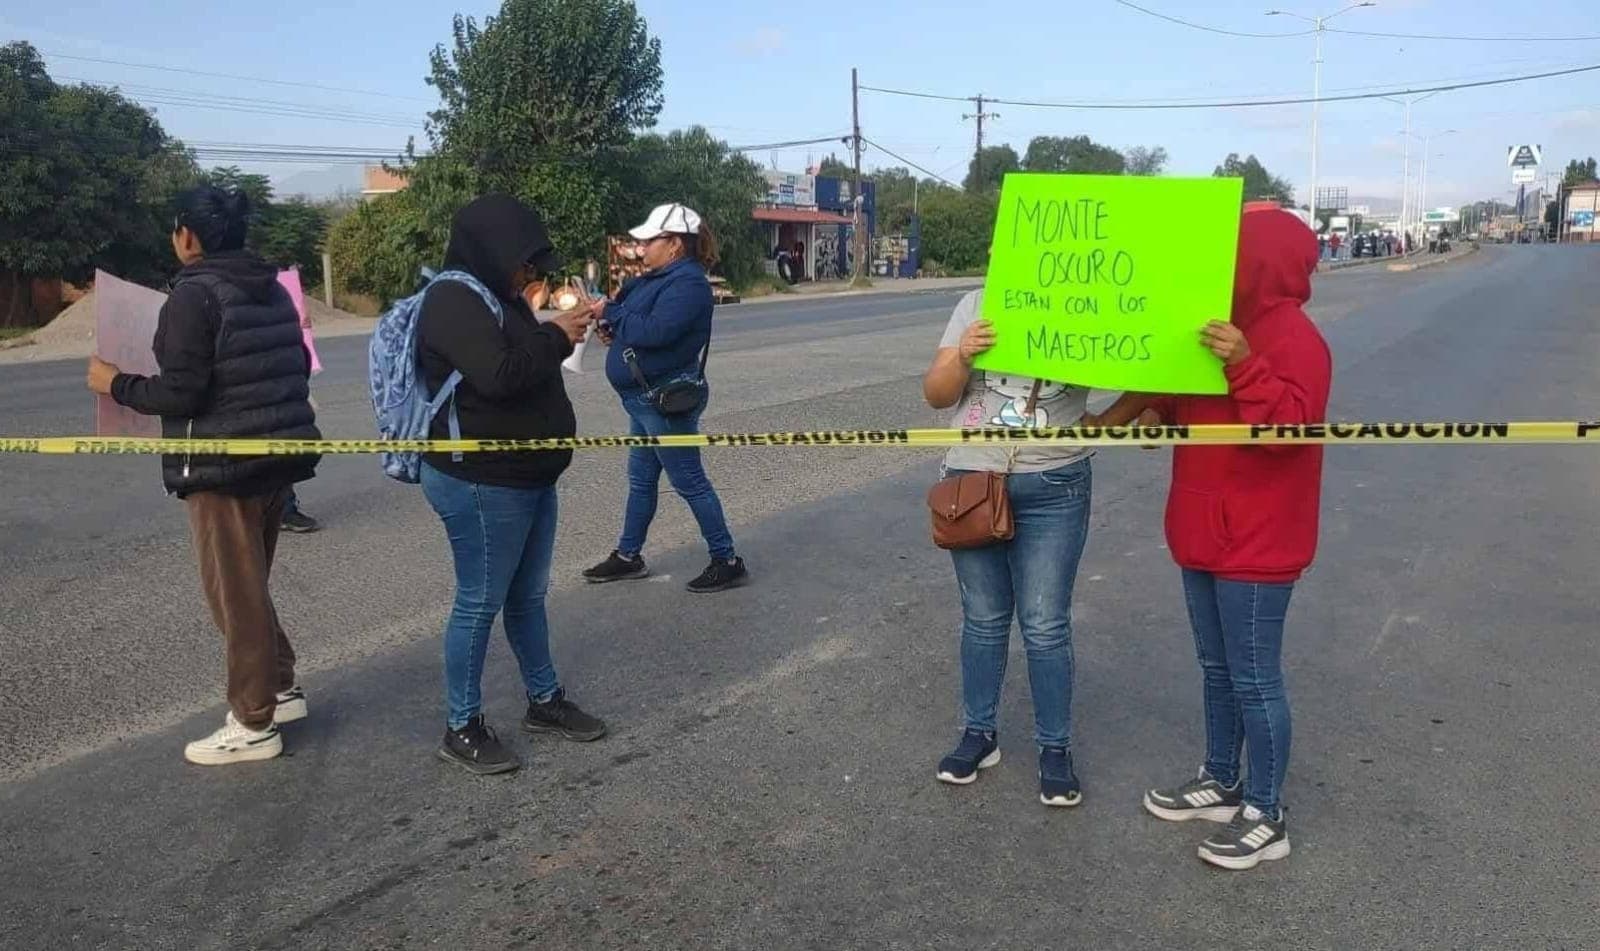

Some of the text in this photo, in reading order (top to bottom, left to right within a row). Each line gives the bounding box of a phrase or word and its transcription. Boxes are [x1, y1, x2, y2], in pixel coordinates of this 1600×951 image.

[1013, 196, 1109, 248] MONTE
[1038, 249, 1134, 288] OSCURO
[1004, 289, 1050, 312] ESTAN
[1064, 296, 1099, 316] CON
[1026, 325, 1155, 362] MAESTROS
